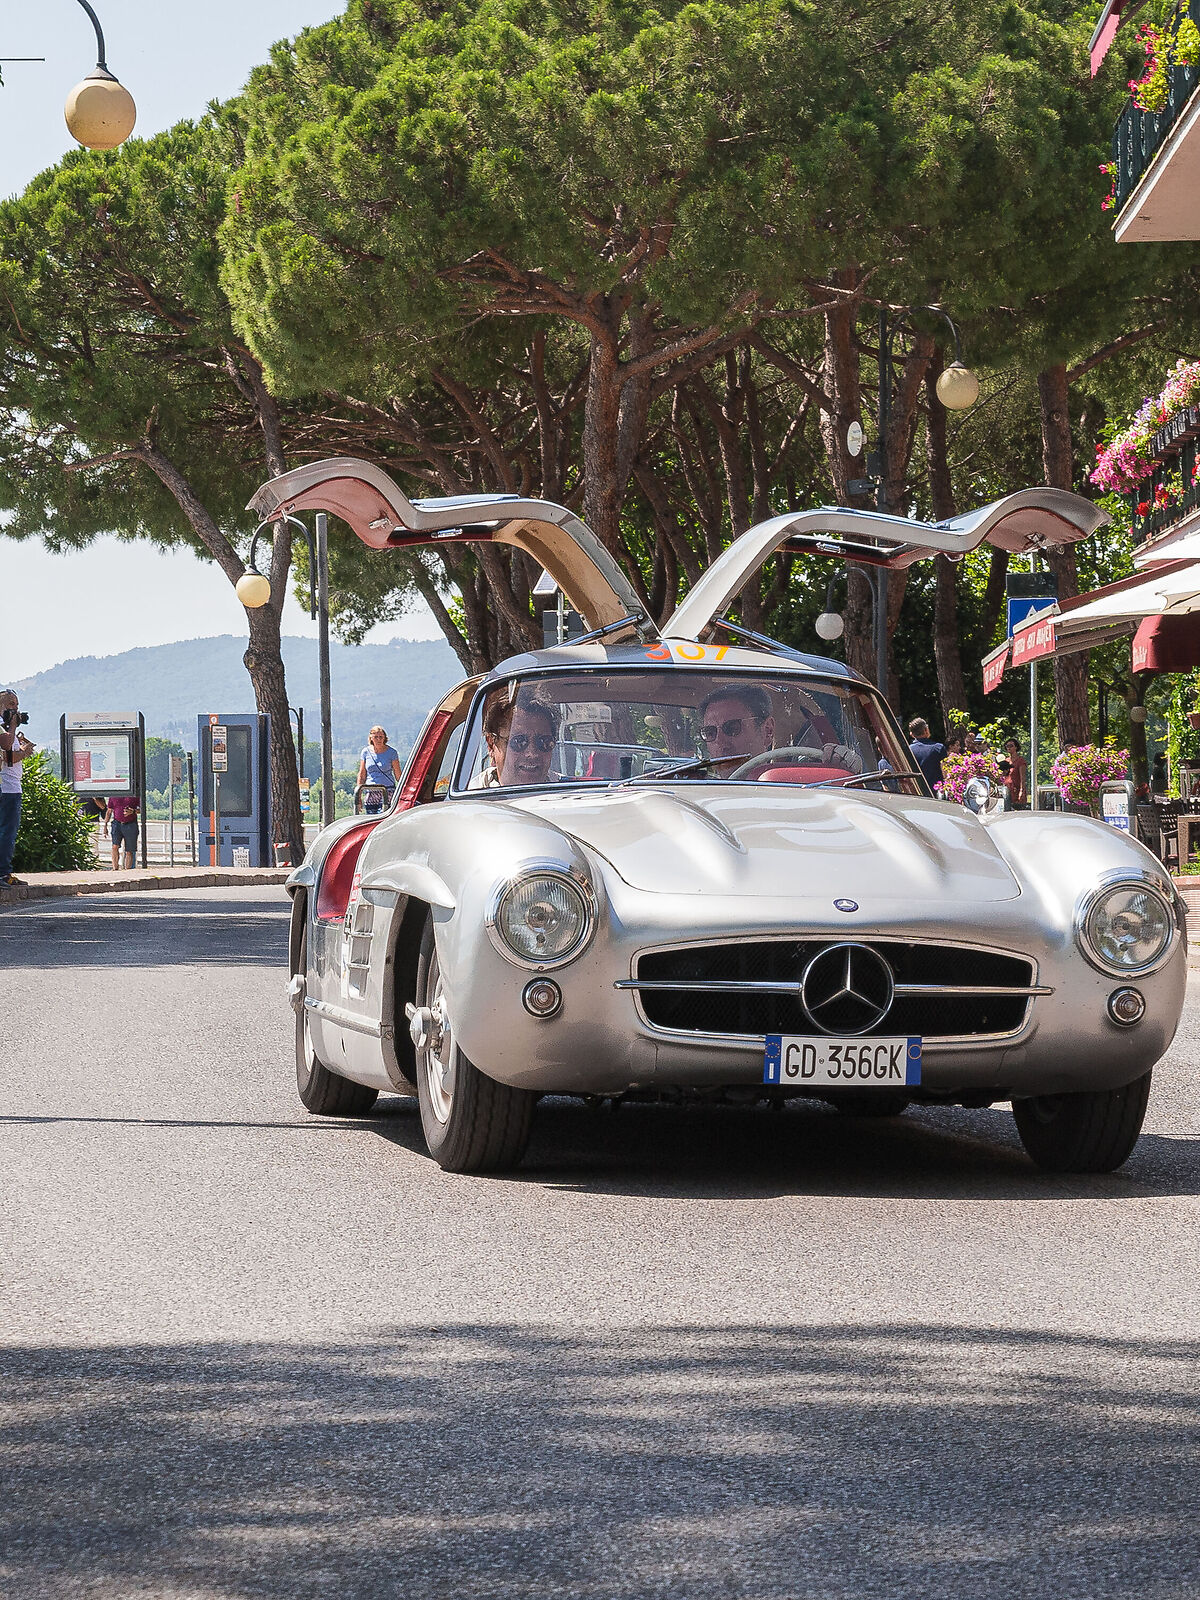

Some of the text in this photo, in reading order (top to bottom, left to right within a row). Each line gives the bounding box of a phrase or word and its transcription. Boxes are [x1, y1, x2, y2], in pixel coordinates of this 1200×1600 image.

[642, 643, 730, 661] 307
[785, 1043, 904, 1079] GD 356GK
